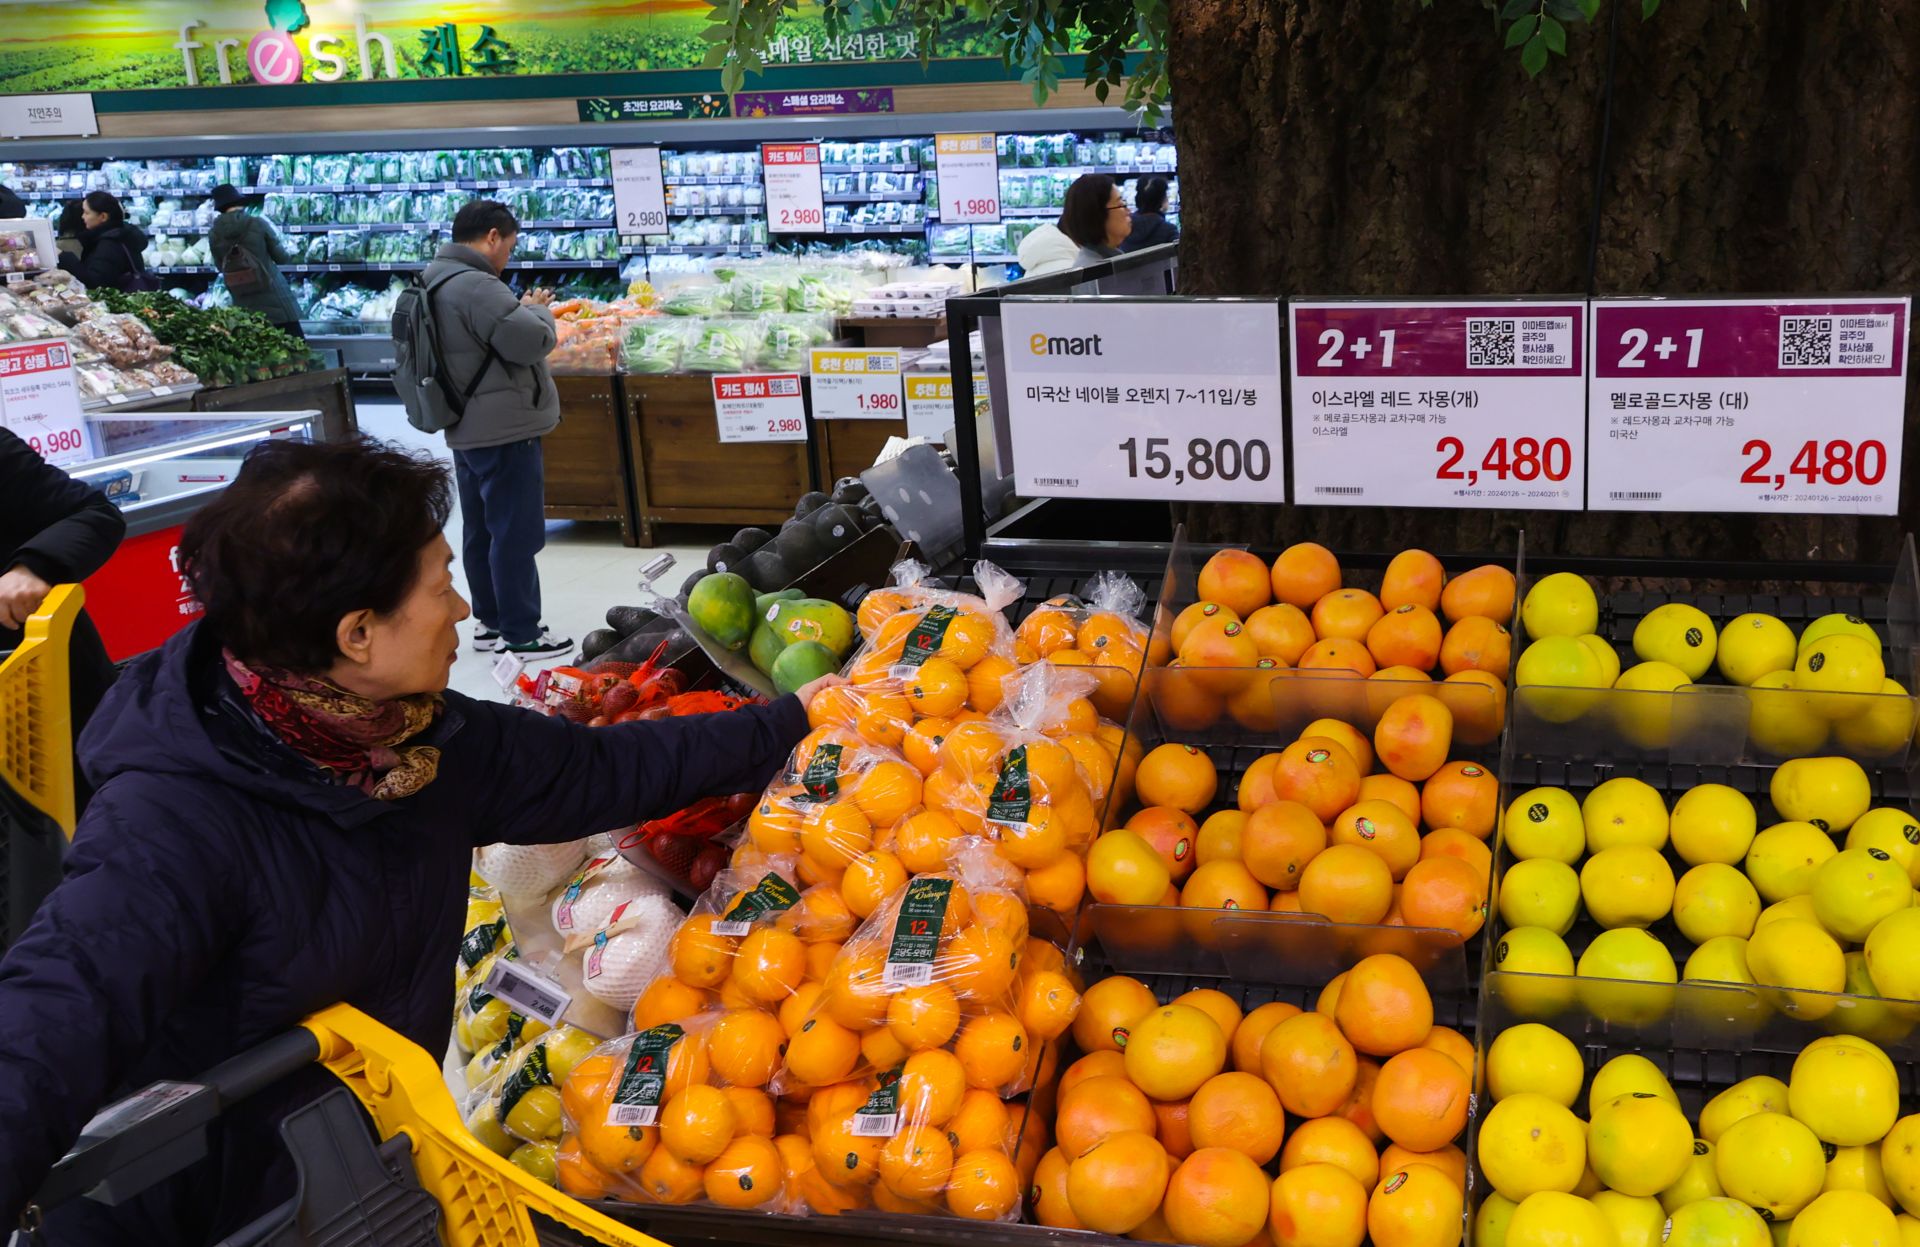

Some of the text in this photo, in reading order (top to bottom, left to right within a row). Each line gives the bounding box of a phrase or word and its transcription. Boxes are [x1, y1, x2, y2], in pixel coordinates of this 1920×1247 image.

[174, 13, 398, 86] fresh
[417, 22, 518, 78] 채소
[821, 33, 889, 61] 신선한
[623, 99, 684, 112] 초간단 요리채소
[809, 93, 845, 105] 요리채소
[768, 151, 785, 163] 카드
[954, 198, 996, 216] 1,980
[628, 211, 664, 227] 2,980
[780, 208, 821, 226] 2,980
[1522, 320, 1567, 330] 이마트앱에서
[1522, 332, 1547, 342] 금주의
[1840, 330, 1866, 341] 금주의
[1029, 333, 1103, 356] emart
[1316, 328, 1396, 368] 2+1
[1522, 343, 1555, 353] 행사상품
[1617, 328, 1704, 368] 2+1
[1839, 342, 1874, 353] 행사상품
[24, 353, 47, 371] 상품
[1522, 355, 1566, 365] 확인하세요!
[1838, 354, 1885, 365] 확인하세요!
[721, 382, 765, 397] 카드 행사
[939, 384, 953, 397] 상
[1026, 386, 1258, 406] 미국산 네이블 오렌지 7~11입/봉
[857, 393, 898, 410] 1,980
[1312, 390, 1479, 408] 이스라엘 레드 자몽(개)
[1610, 391, 1749, 410] 멜로골드자몽 (대)
[767, 418, 802, 433] 2,980
[1323, 413, 1386, 424] 메로골드자몽과
[1389, 413, 1426, 424] 교차구매
[1428, 413, 1447, 424] 가능
[1622, 415, 1670, 426] 레드자몽과
[1673, 416, 1712, 426] 교차구매
[1715, 416, 1735, 426] 가능
[1312, 426, 1348, 437] 이스라엘
[1609, 429, 1638, 440] 미국산
[1118, 437, 1271, 486] 15,800
[1435, 436, 1572, 487] 2,480
[1740, 439, 1887, 491] 2,480
[917, 634, 931, 650] 12
[911, 920, 928, 935] 12
[636, 1056, 655, 1073] 12
